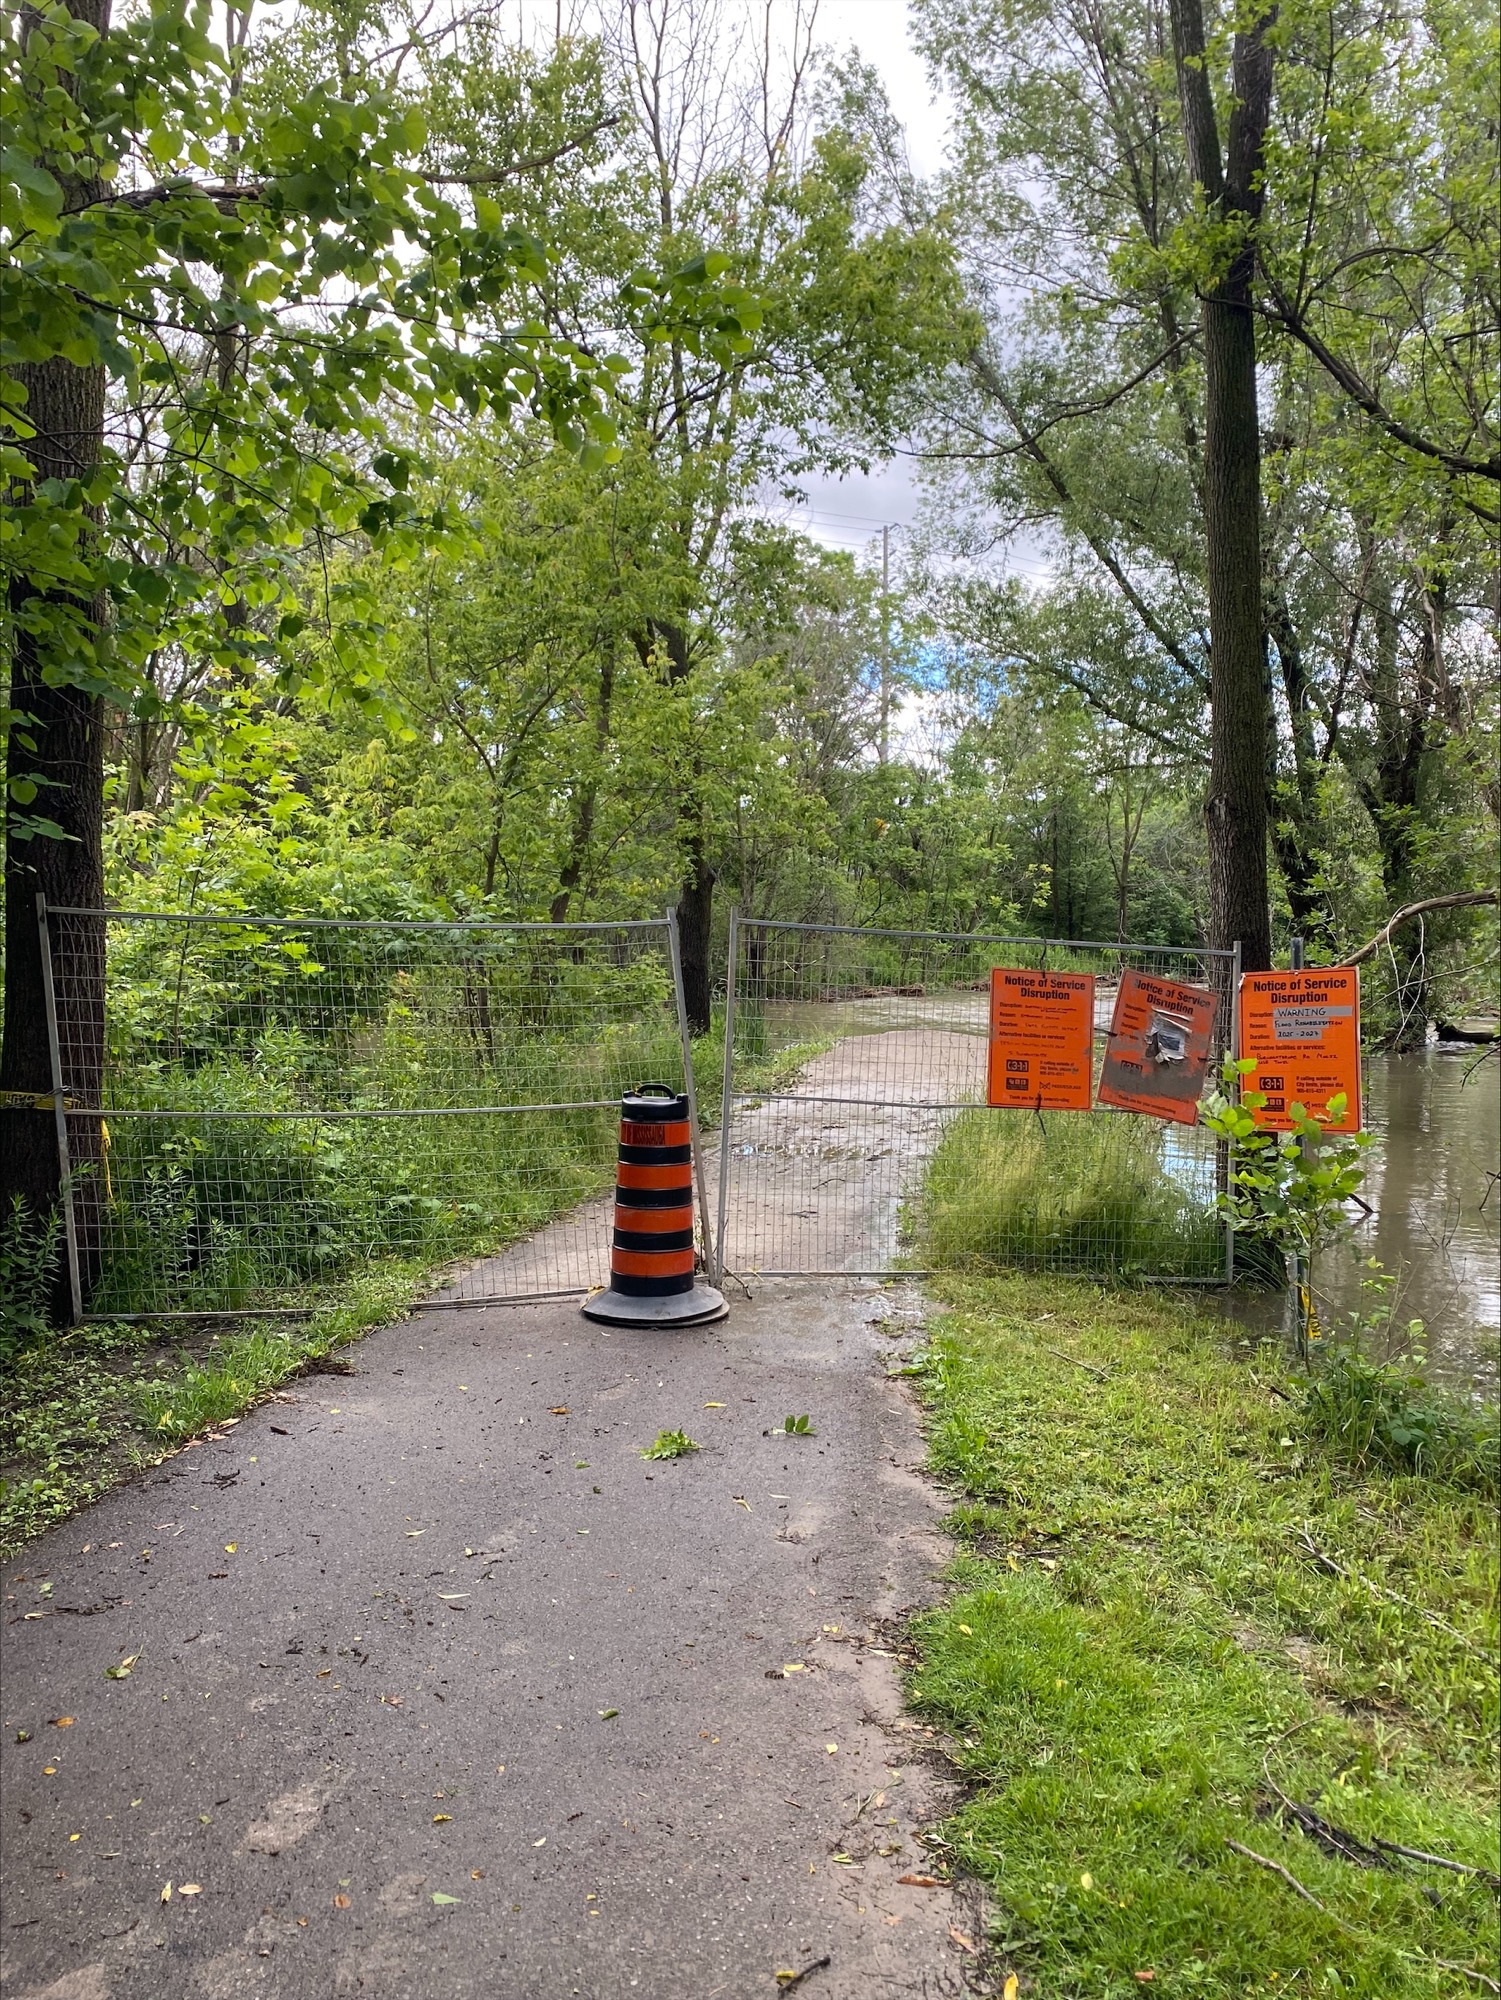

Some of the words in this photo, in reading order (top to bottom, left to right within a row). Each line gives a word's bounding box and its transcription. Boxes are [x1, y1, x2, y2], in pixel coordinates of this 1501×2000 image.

[1005, 976, 1035, 986] Notice
[1038, 979, 1047, 987] of
[1050, 980, 1085, 990] Service
[1254, 981, 1286, 992] Notice
[1290, 979, 1300, 990] of
[1304, 978, 1347, 990] Service
[1021, 988, 1070, 1000] Disruption
[1133, 979, 1163, 995] Notice
[1165, 989, 1175, 998] of
[1177, 991, 1211, 1008] Service
[1271, 991, 1328, 1005] Disruption
[1147, 993, 1193, 1015] Disruption
[1278, 1008, 1327, 1017] WARNING
